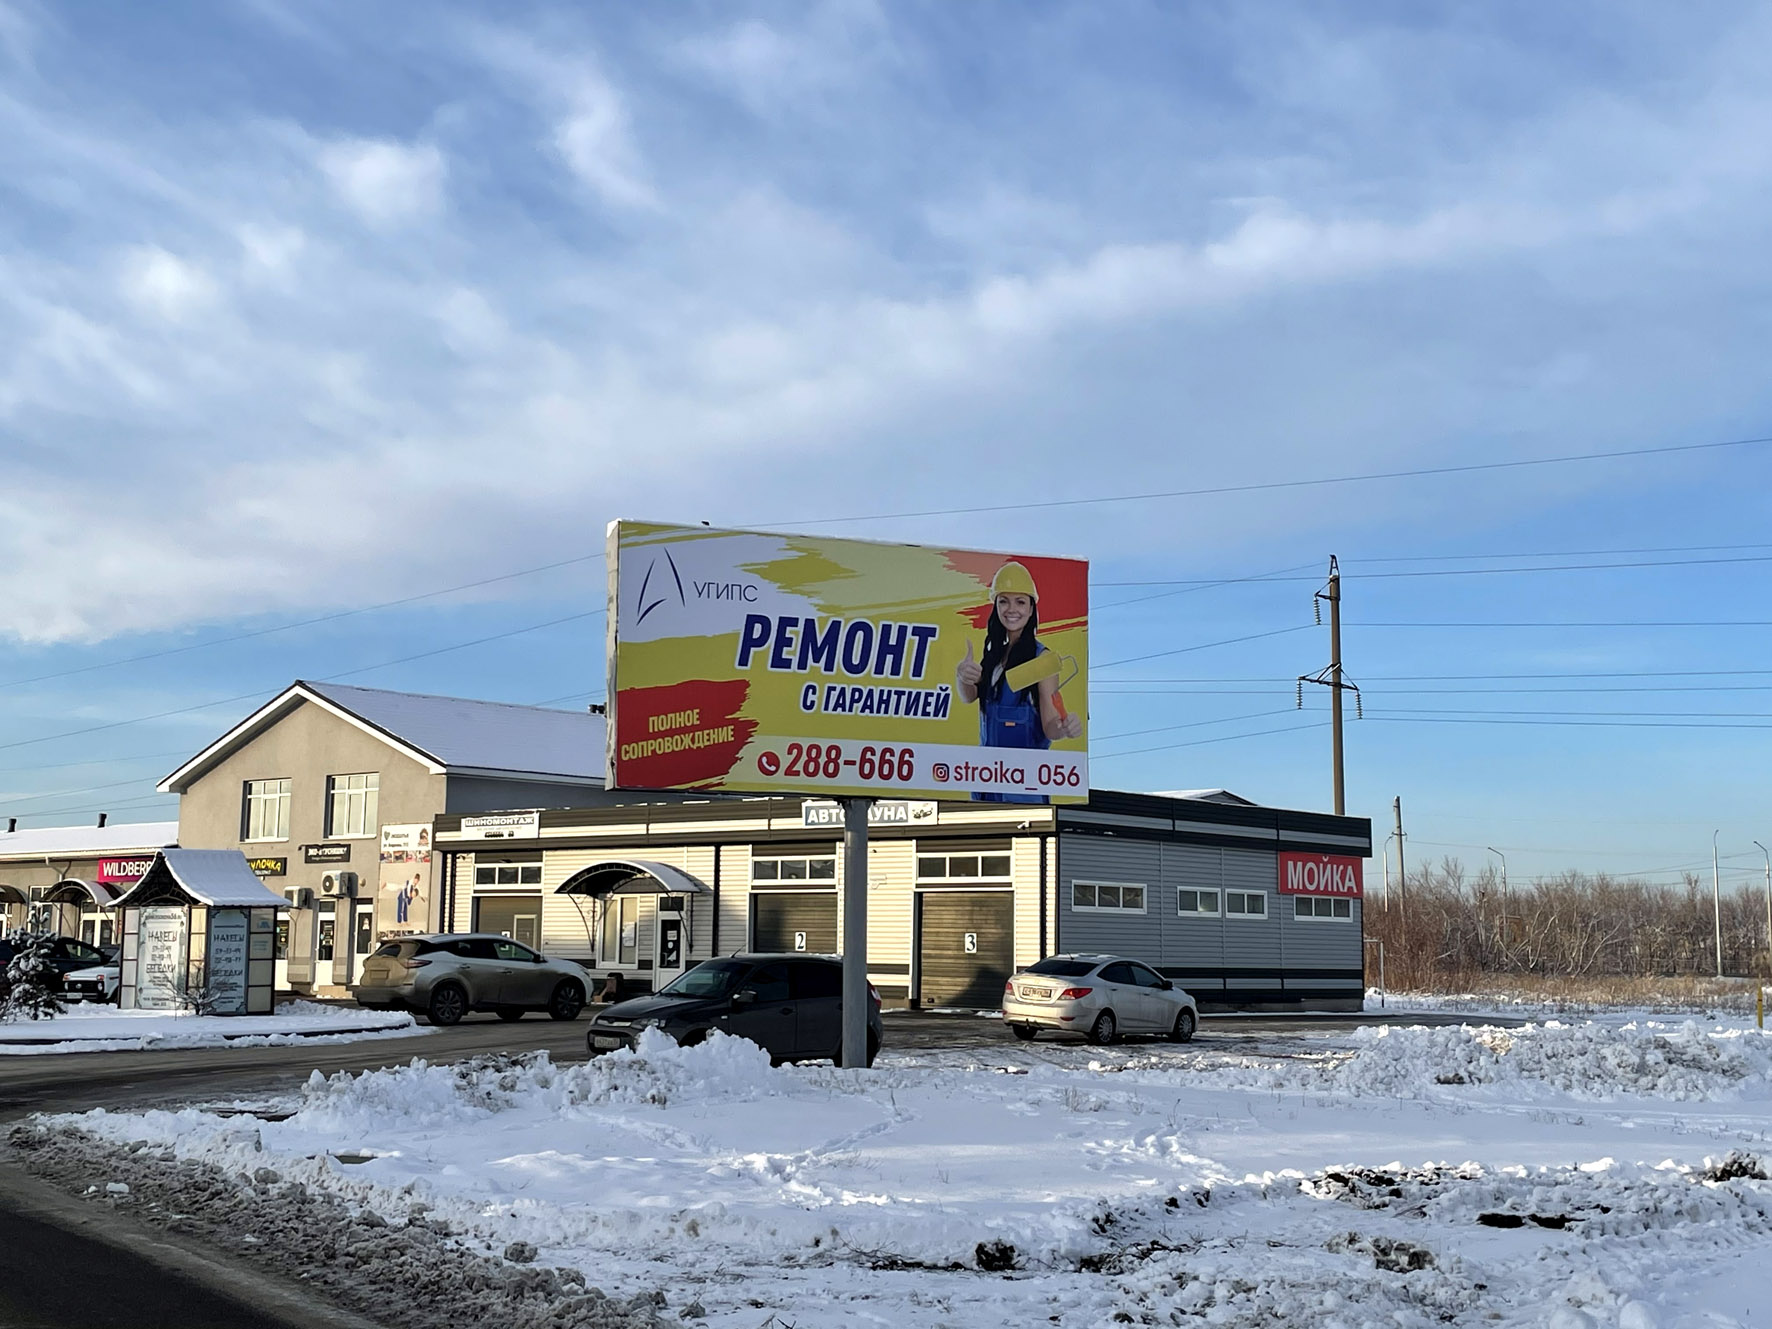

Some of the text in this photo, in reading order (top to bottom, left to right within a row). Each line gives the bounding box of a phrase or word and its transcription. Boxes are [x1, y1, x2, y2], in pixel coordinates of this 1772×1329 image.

[737, 613, 938, 678] РЕМОНТ
[802, 684, 951, 718] С ГАРАНТИЕЙ
[648, 709, 700, 733] ПОЛНОЕ
[621, 725, 735, 761] СОПРОВОЖДЕНИЕ
[784, 742, 915, 782] 288-666
[953, 760, 1081, 791] stroika_056
[465, 816, 535, 827] ШИНОМОНТАЖ
[807, 806, 907, 823] АВТУНА
[248, 859, 282, 873] УЛОЧКА
[1287, 856, 1358, 893] МОЙКА
[797, 933, 804, 949] 2
[966, 934, 976, 951] 3
